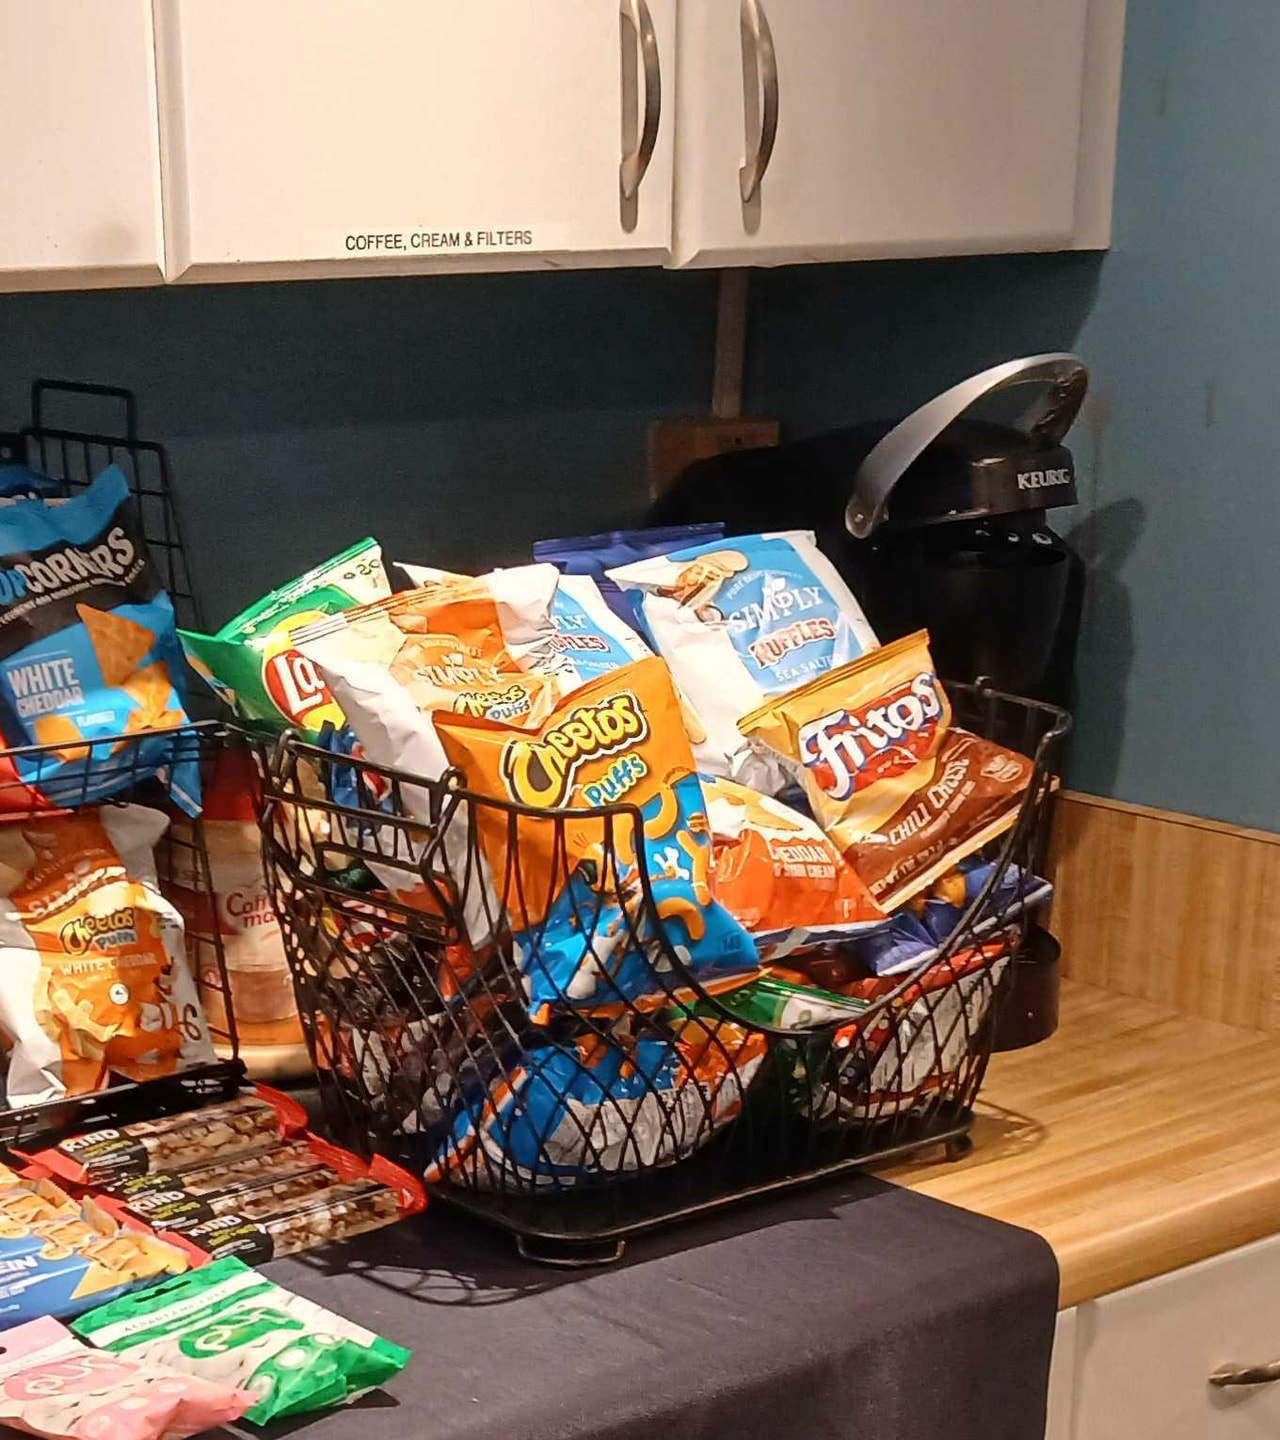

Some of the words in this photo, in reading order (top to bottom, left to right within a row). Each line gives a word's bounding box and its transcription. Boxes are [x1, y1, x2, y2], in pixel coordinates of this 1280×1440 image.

[345, 234, 407, 251] COFFEE,
[410, 232, 460, 248] CREAM
[464, 231, 473, 247] &
[477, 230, 533, 246] FILTERS
[1017, 467, 1071, 490] KEURIG
[727, 586, 824, 633] SIMPLY
[749, 618, 836, 668] RUFFLES
[7, 657, 80, 698] WHITE
[508, 695, 642, 809] Cheetos
[798, 672, 943, 801] Fritos
[888, 802, 933, 845] CHILI
[60, 906, 135, 956] Cheetos
[61, 962, 105, 977] WHITE
[60, 1128, 121, 1152] KIND
[128, 1190, 186, 1214] KIND
